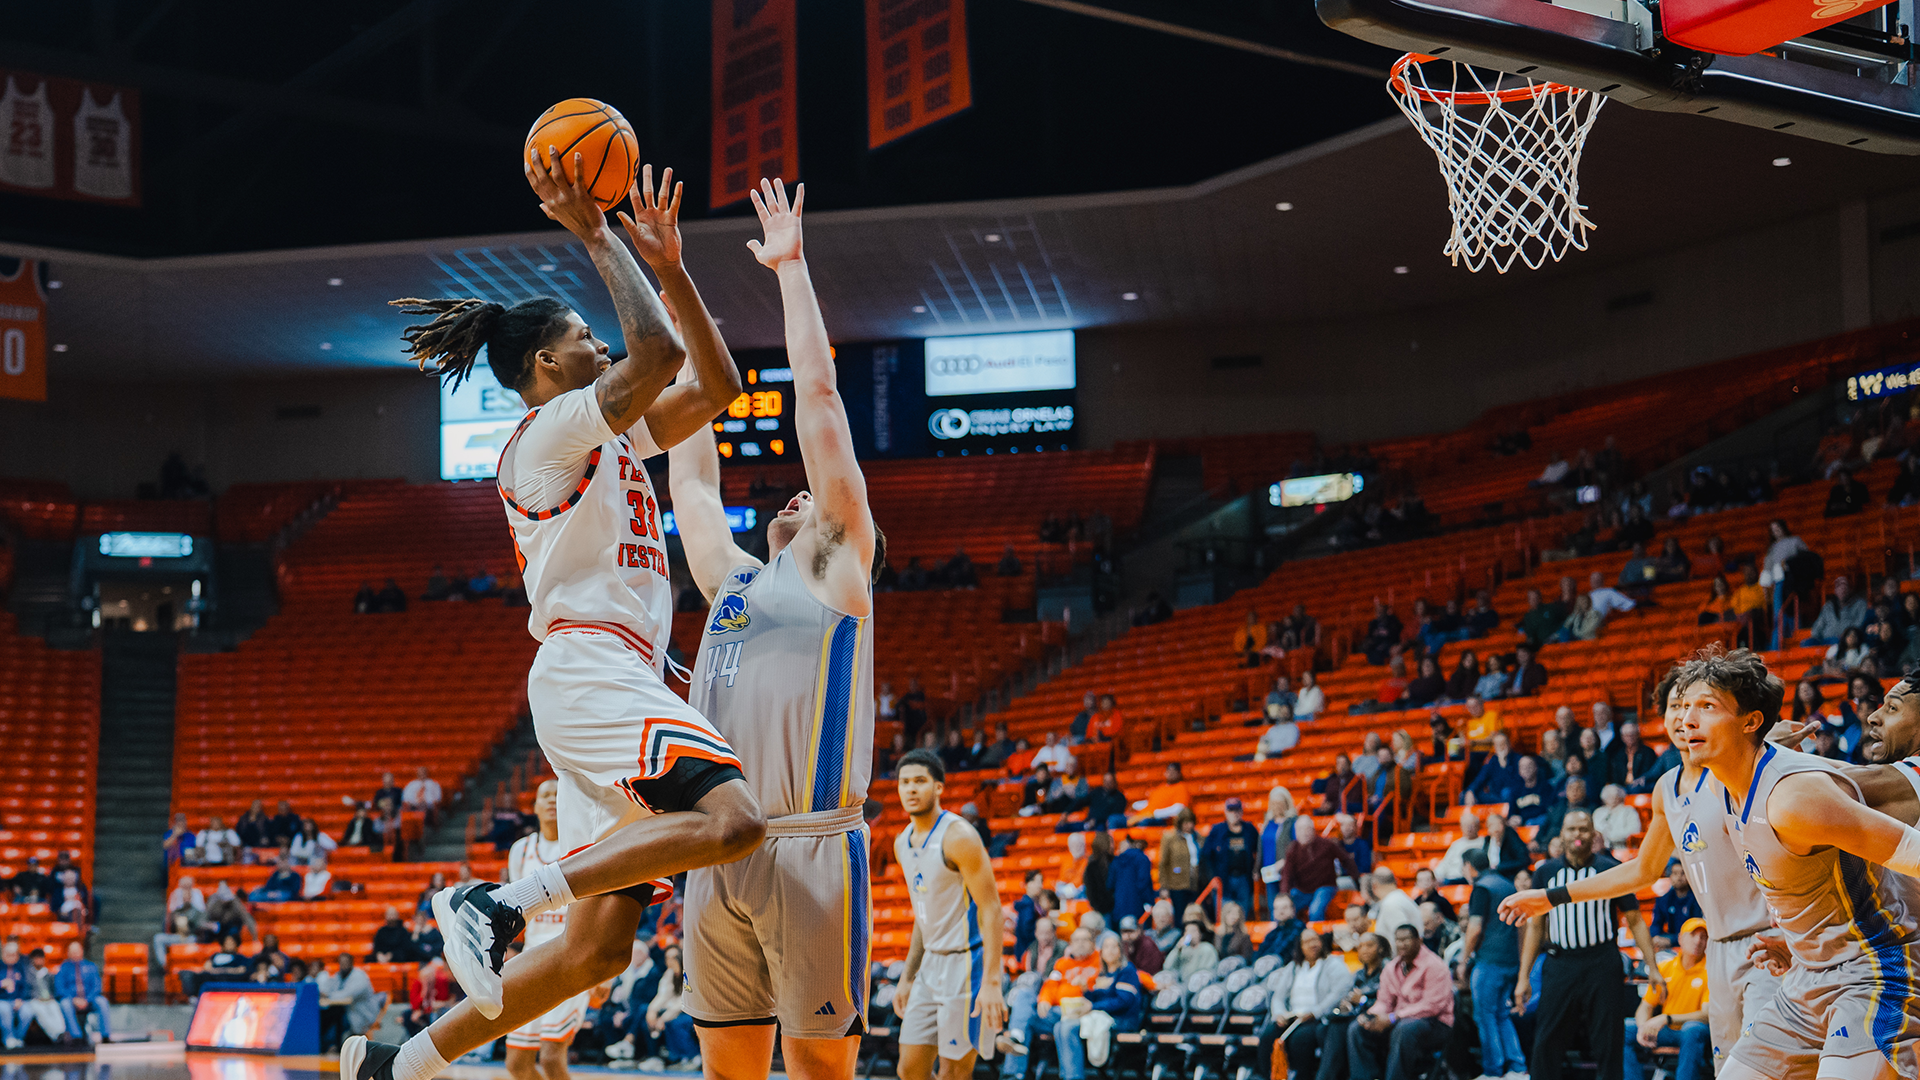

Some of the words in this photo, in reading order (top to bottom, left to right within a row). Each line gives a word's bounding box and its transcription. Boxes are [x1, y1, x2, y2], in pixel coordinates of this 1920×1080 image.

[0, 328, 25, 376] 0
[985, 357, 1015, 369] Audi
[970, 421, 1032, 437] INJURY
[1034, 421, 1074, 432] LAW
[1012, 405, 1074, 423] ORNELAS
[626, 489, 659, 542] 33
[705, 640, 744, 691] 44
[1690, 861, 1708, 894] 11
